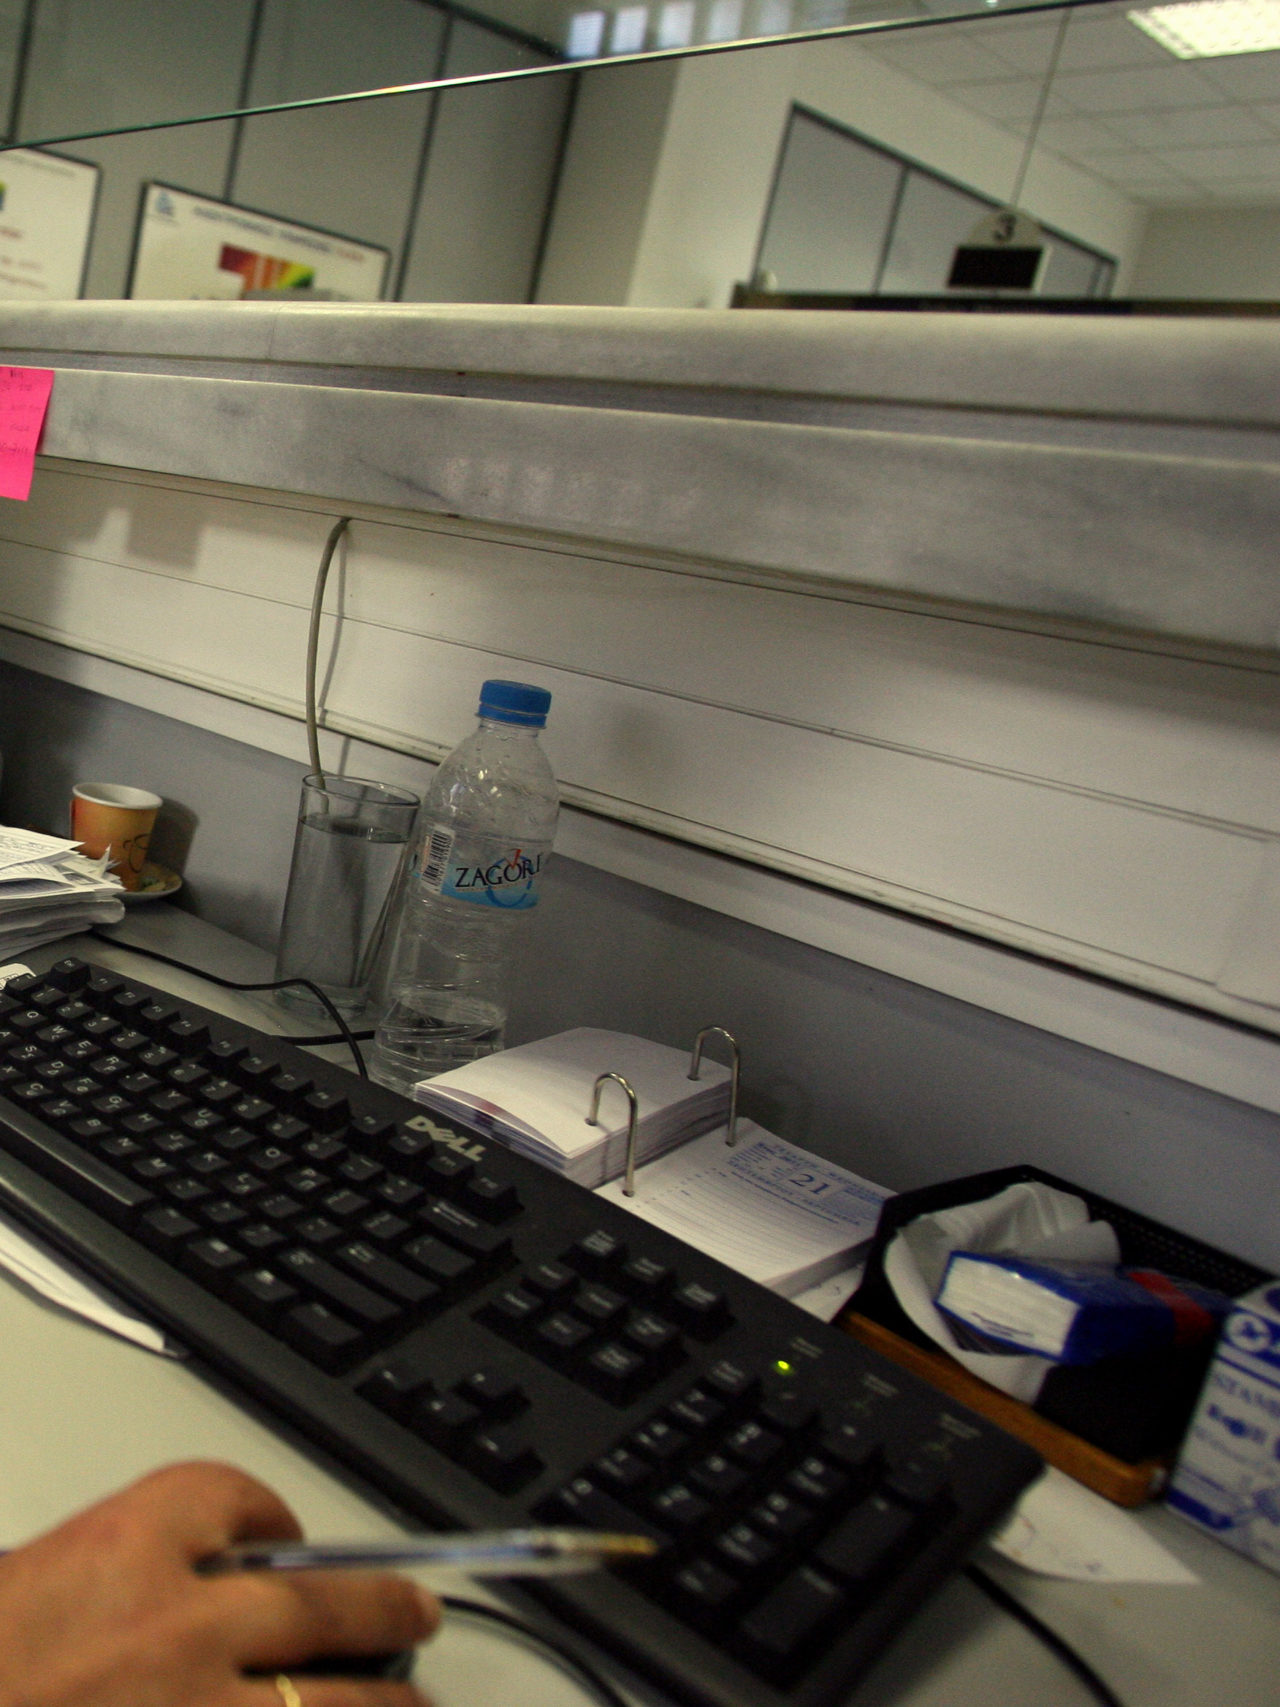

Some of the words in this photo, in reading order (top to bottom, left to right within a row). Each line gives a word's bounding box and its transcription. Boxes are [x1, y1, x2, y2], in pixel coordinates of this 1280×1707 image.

[455, 855, 543, 889] ZAGORI
[405, 1115, 487, 1162] DELL
[788, 1172, 830, 1196] 21
